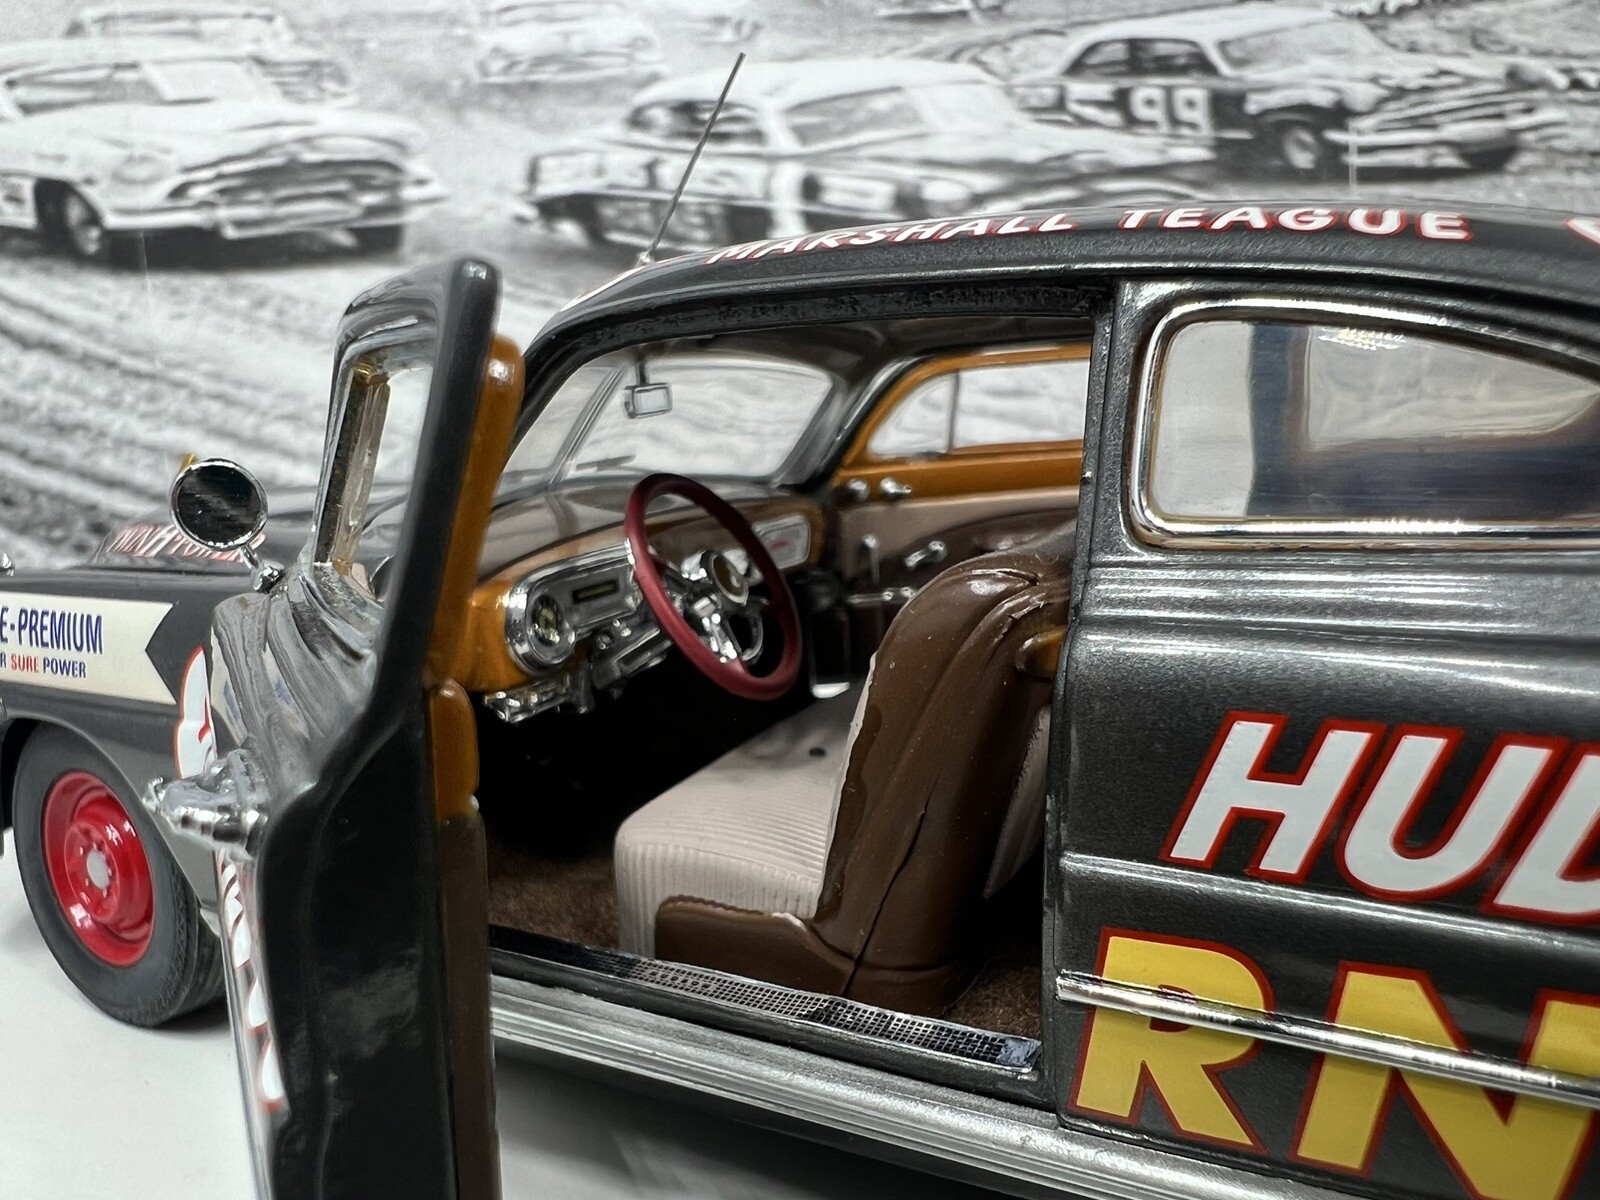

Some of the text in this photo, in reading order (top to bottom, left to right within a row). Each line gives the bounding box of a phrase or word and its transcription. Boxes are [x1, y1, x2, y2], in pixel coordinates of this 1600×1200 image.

[1129, 84, 1216, 138] 99
[703, 206, 1474, 265] MARSHALL TEAGUE
[0, 605, 103, 655] E-PREMIUM
[11, 652, 39, 674] SURE
[42, 656, 87, 679] POWER
